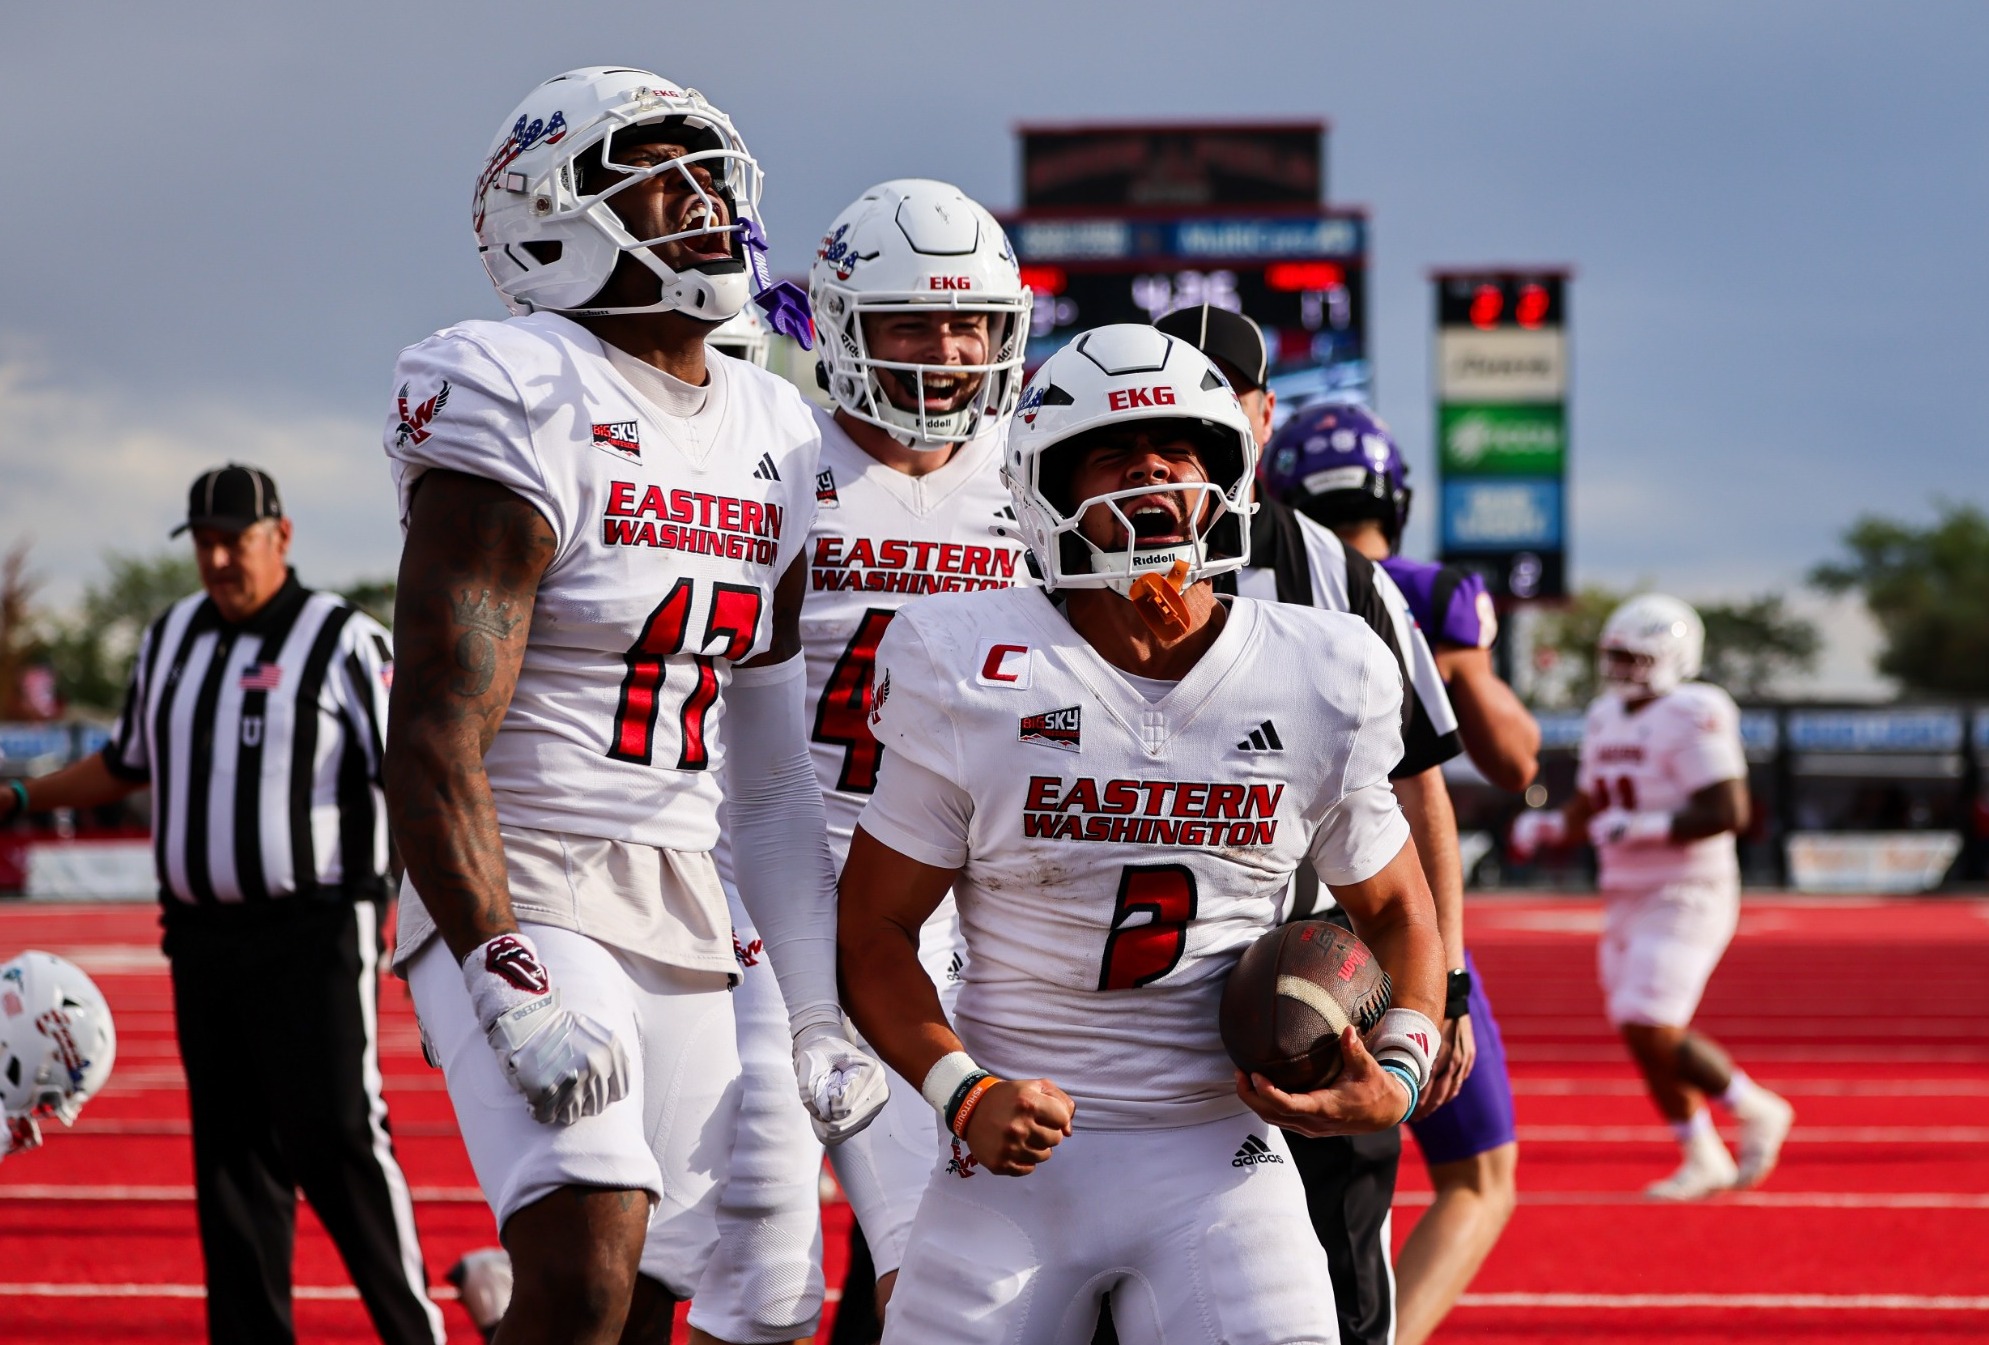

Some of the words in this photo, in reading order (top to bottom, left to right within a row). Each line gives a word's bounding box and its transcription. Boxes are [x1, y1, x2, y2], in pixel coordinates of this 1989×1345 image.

[653, 89, 680, 98] EKG
[930, 276, 970, 290] EKG
[1107, 386, 1177, 412] EKG
[915, 417, 952, 428] Rddell
[604, 480, 783, 540] EASTERN
[603, 519, 780, 567] WASHINGTON
[812, 537, 1022, 578] EASTERN
[1132, 553, 1176, 566] Riddell
[605, 577, 762, 771] 17
[981, 643, 1028, 683] C
[242, 716, 262, 747] U
[1045, 709, 1079, 730] SKY
[1024, 776, 1285, 819] EASTERN
[1023, 813, 1279, 846] WASHINGTON
[1097, 863, 1198, 992] 2
[1231, 1153, 1284, 1168] adidas
